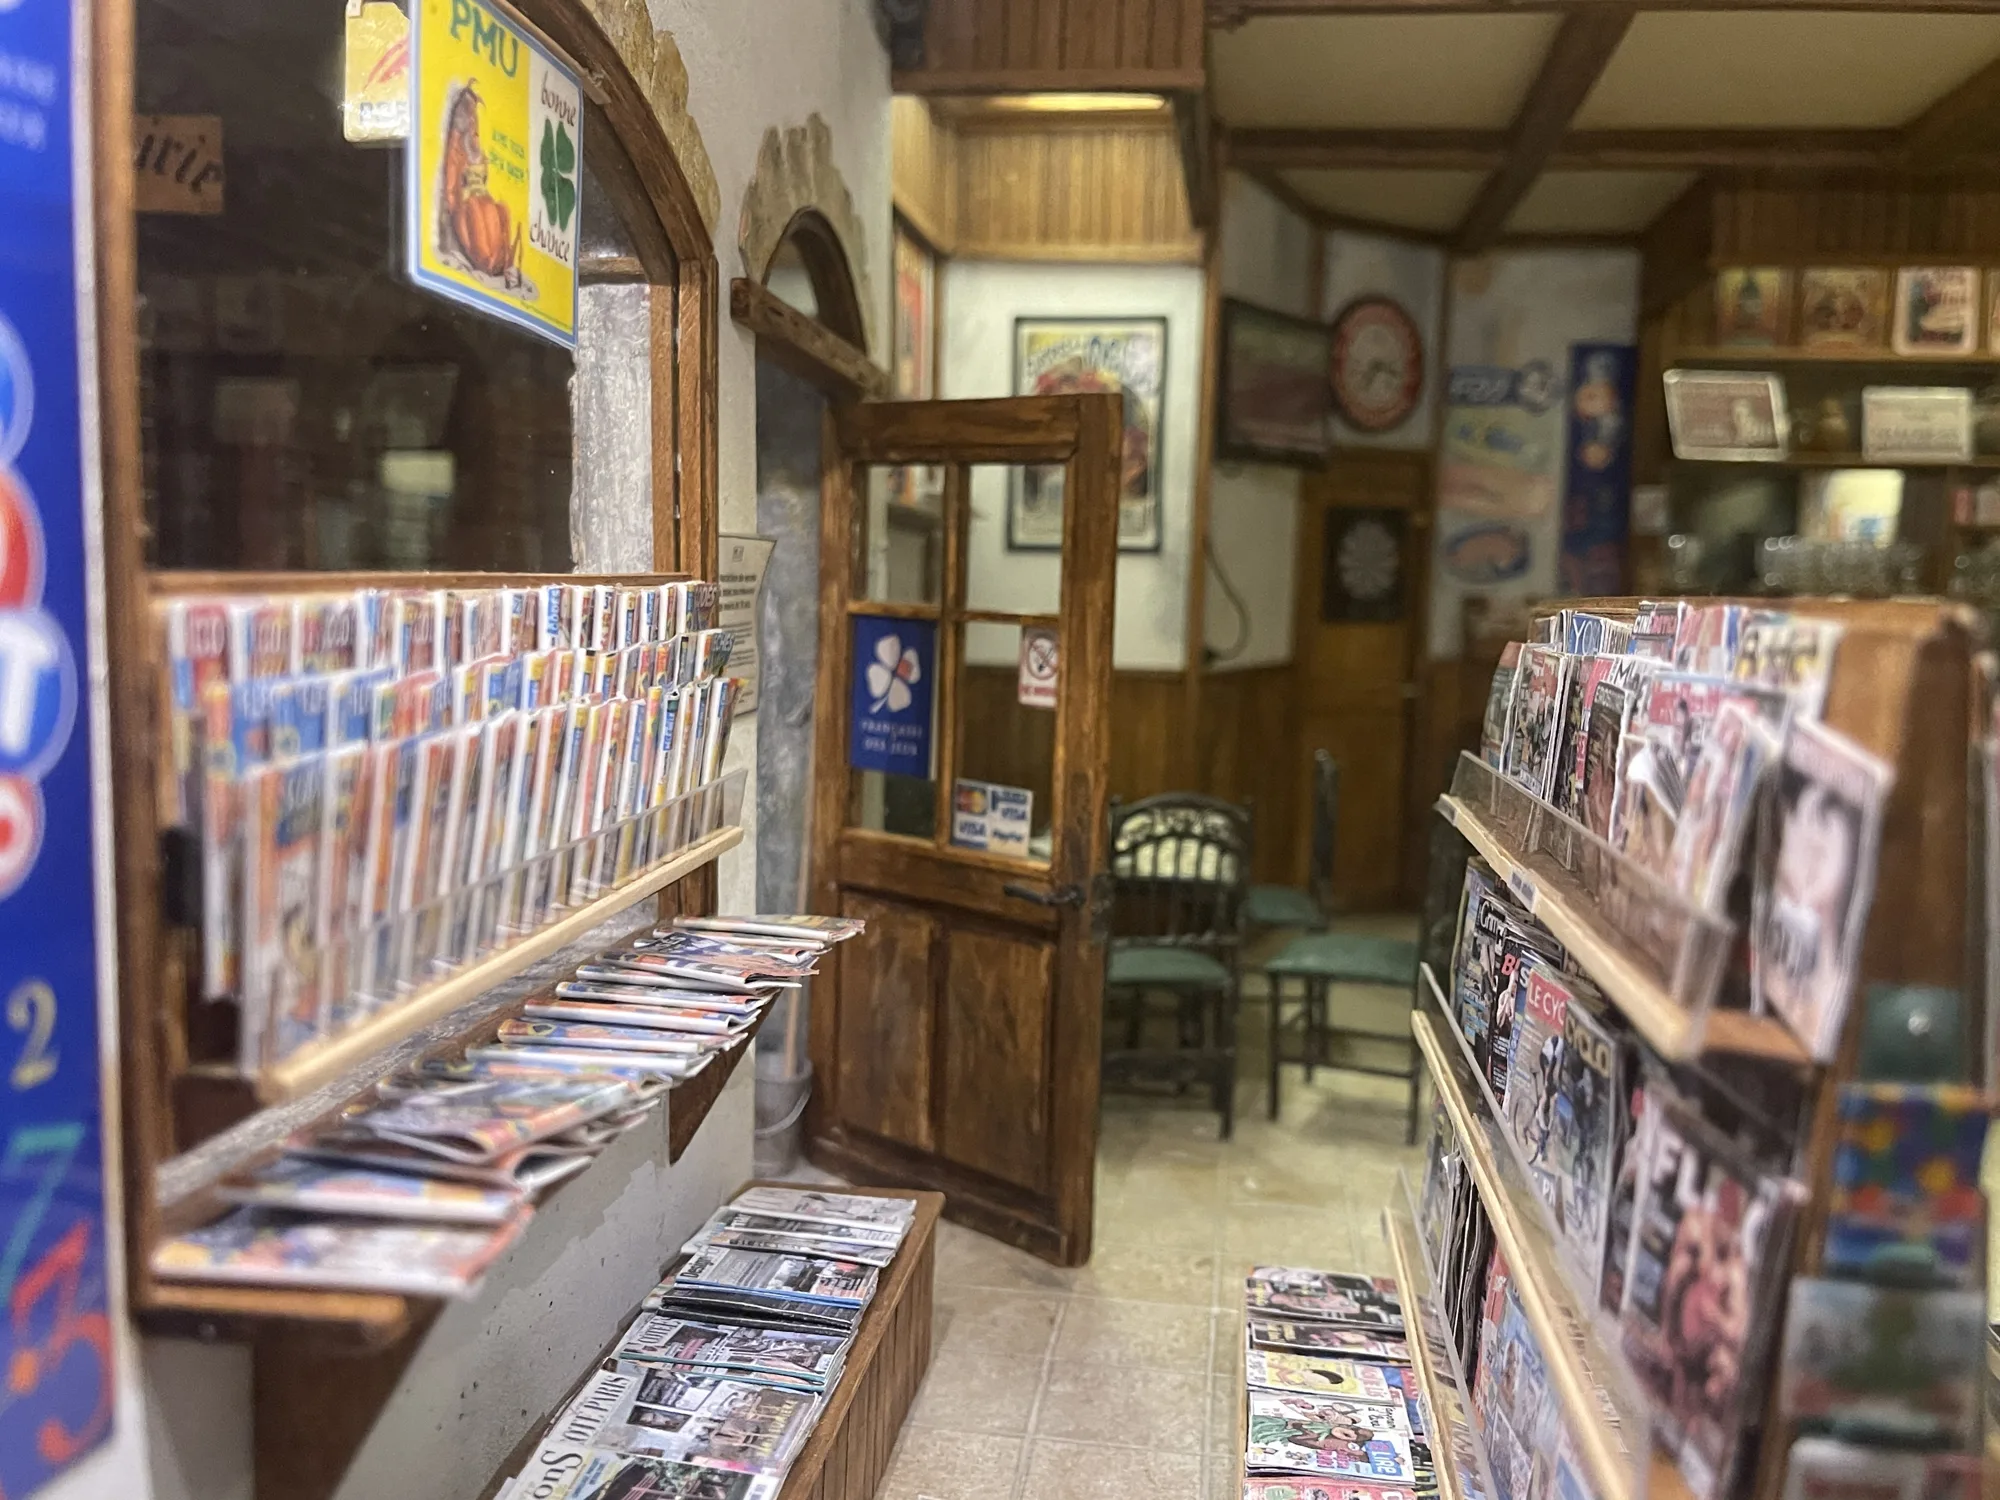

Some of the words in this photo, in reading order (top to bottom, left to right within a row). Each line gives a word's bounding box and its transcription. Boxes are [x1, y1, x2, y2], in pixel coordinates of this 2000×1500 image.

[450, 0, 519, 78] PMU
[540, 70, 577, 128] bonne
[529, 210, 571, 263] chance
[1528, 981, 1542, 1009] LE
[8, 978, 58, 1088] 2
[589, 1374, 630, 1417] PARIS
